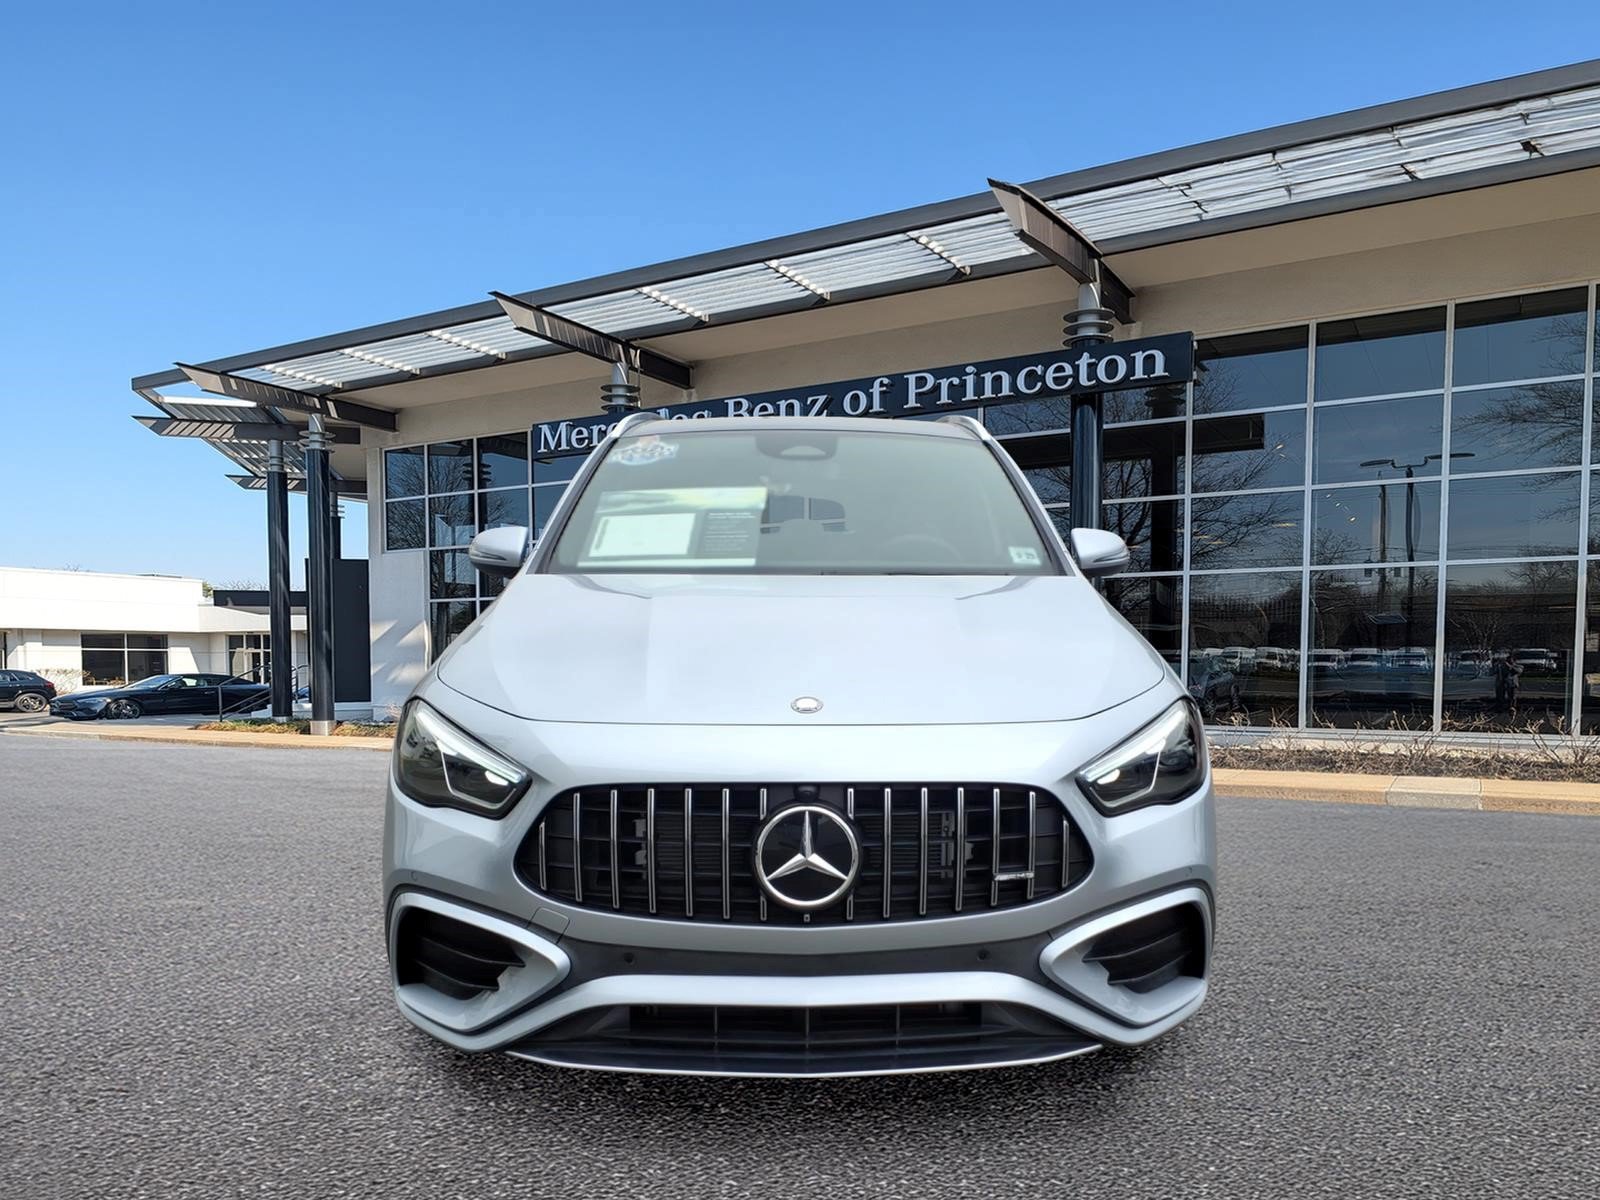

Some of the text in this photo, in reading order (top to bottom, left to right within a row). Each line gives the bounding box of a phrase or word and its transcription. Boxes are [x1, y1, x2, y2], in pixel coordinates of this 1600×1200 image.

[537, 407, 712, 453] Merc
[724, 394, 829, 418] Benz
[842, 377, 891, 416] of
[903, 348, 1169, 408] Princeton
